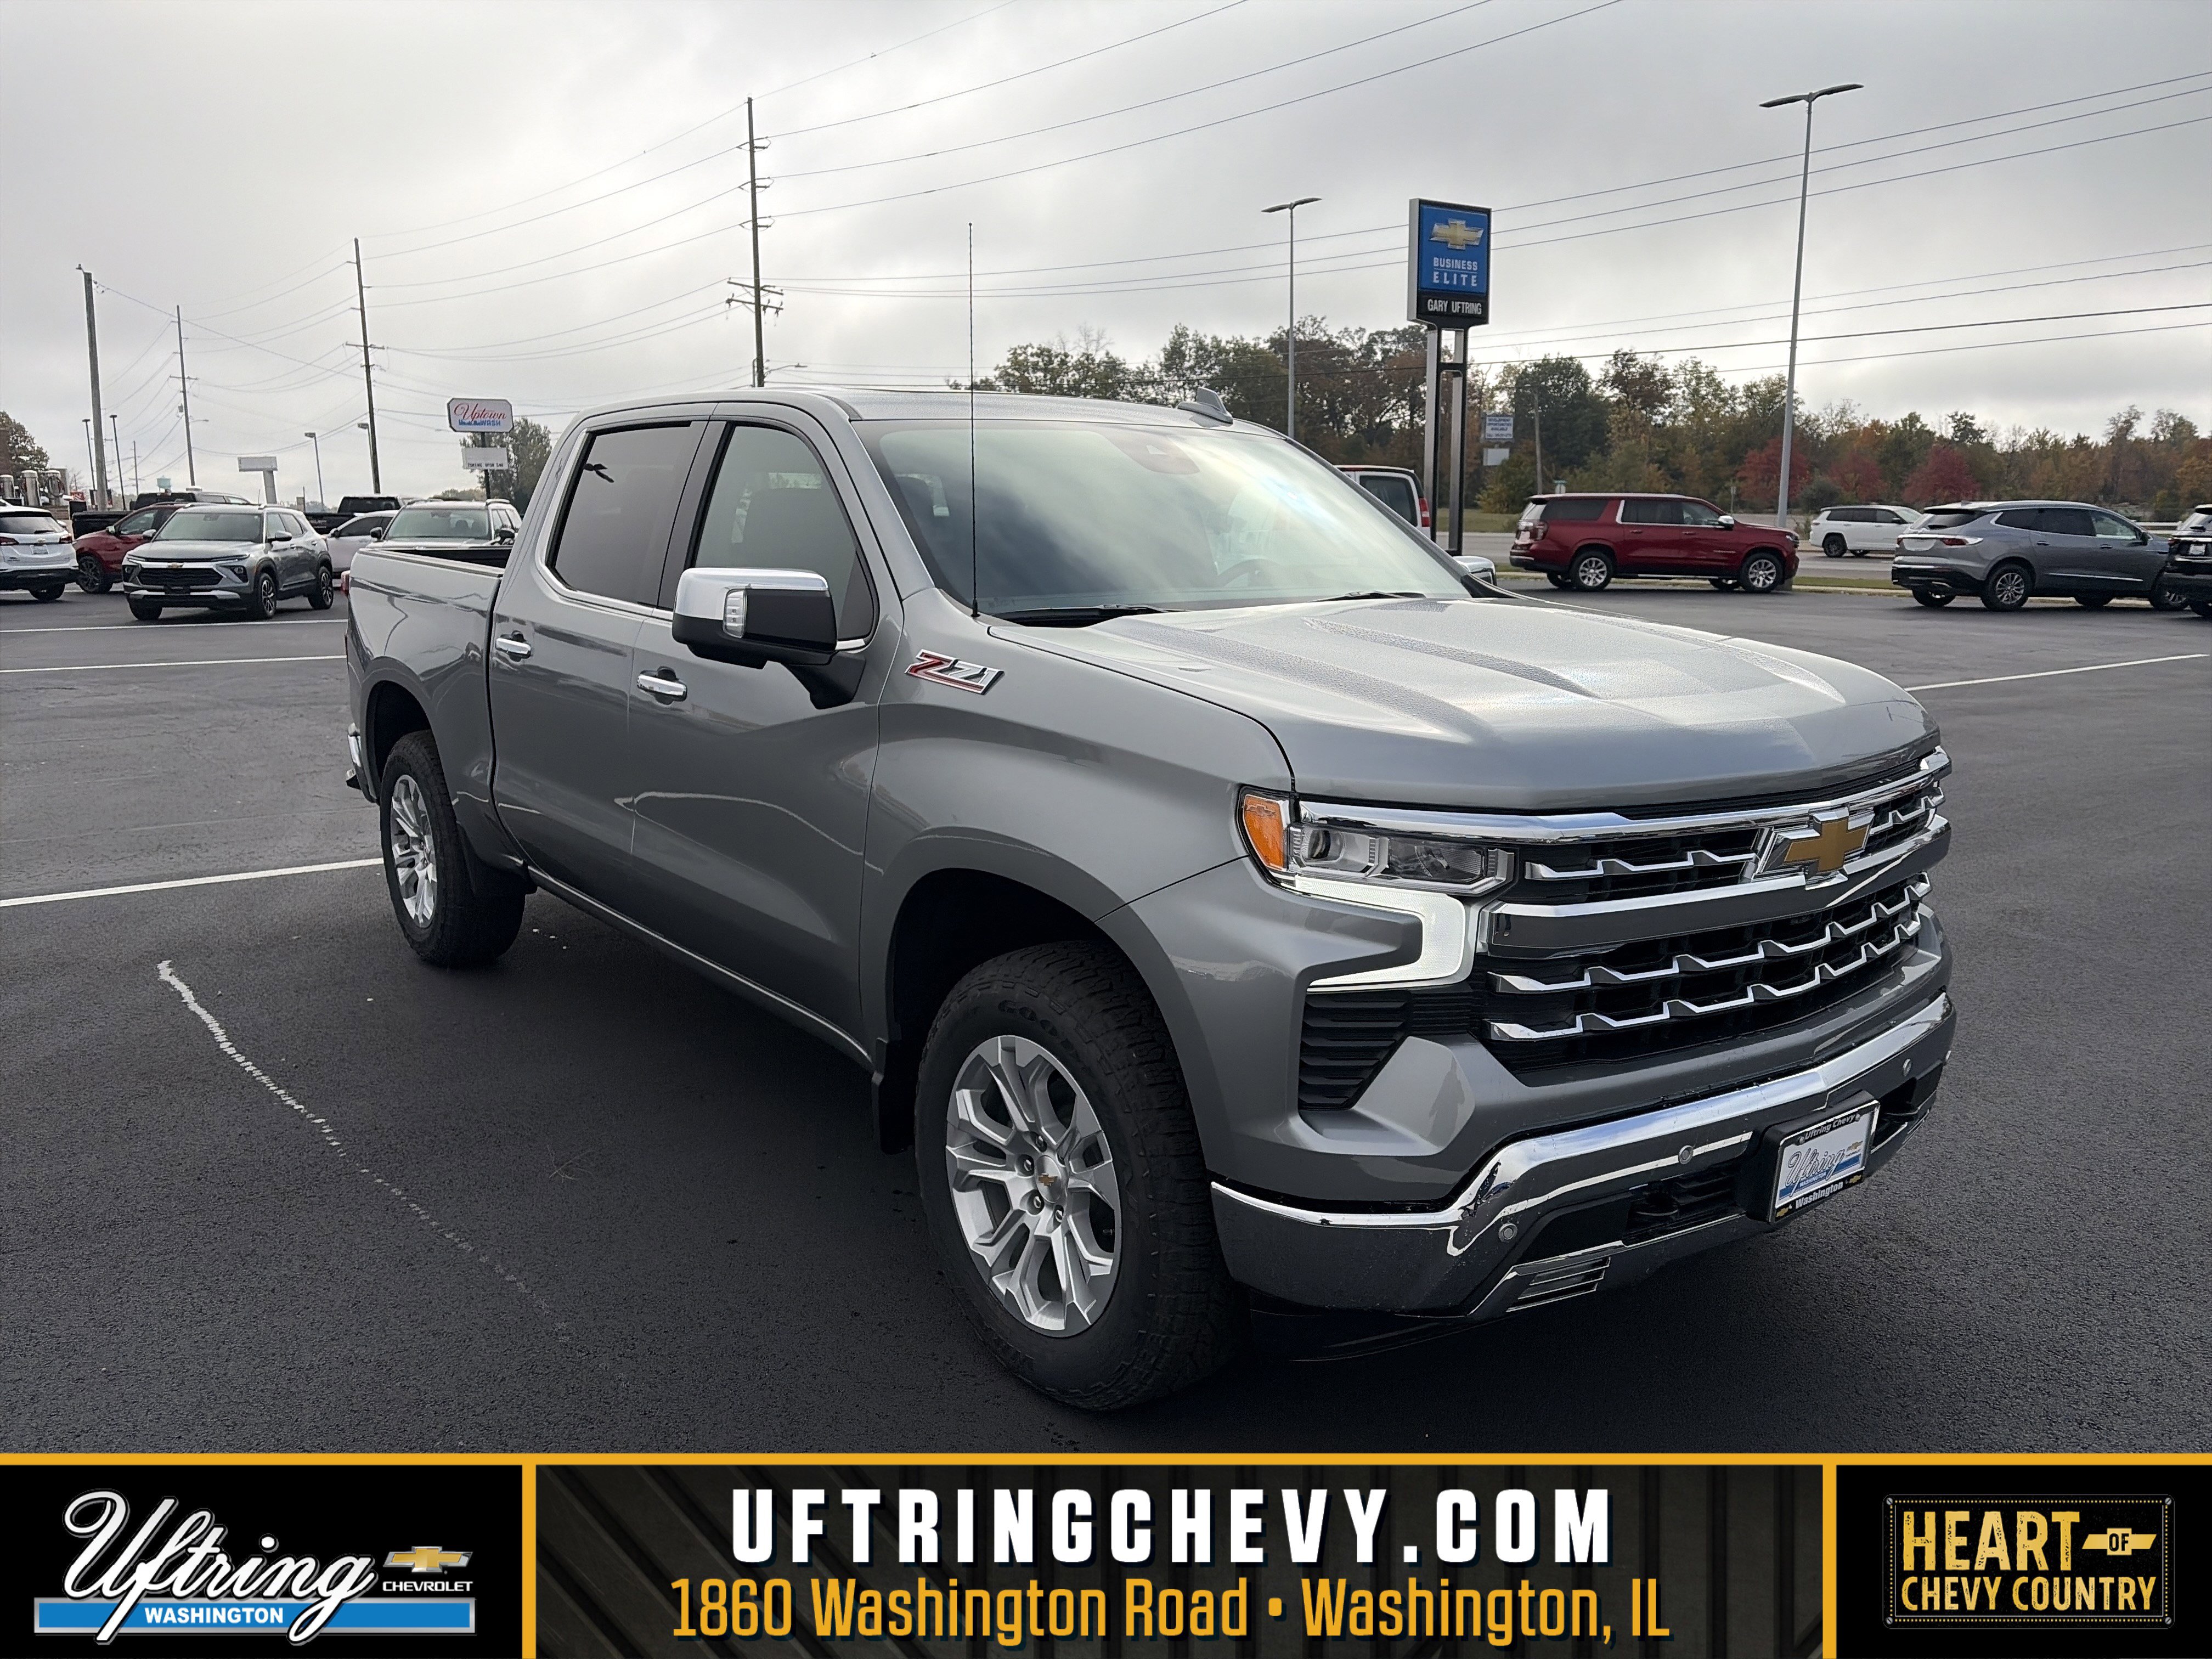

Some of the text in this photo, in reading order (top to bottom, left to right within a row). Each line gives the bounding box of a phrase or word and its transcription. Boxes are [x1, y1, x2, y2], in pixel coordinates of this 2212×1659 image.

[1433, 257, 1477, 270] BUSINESS
[1433, 272, 1477, 286] ELITE
[1427, 299, 1482, 314] GARY UFTRING
[454, 402, 507, 422] Uptown
[904, 649, 1005, 695] Z71
[1832, 1114, 1855, 1128] Chevy
[1799, 1171, 1827, 1188] WASHINGTON
[1795, 1182, 1843, 1209] Washington
